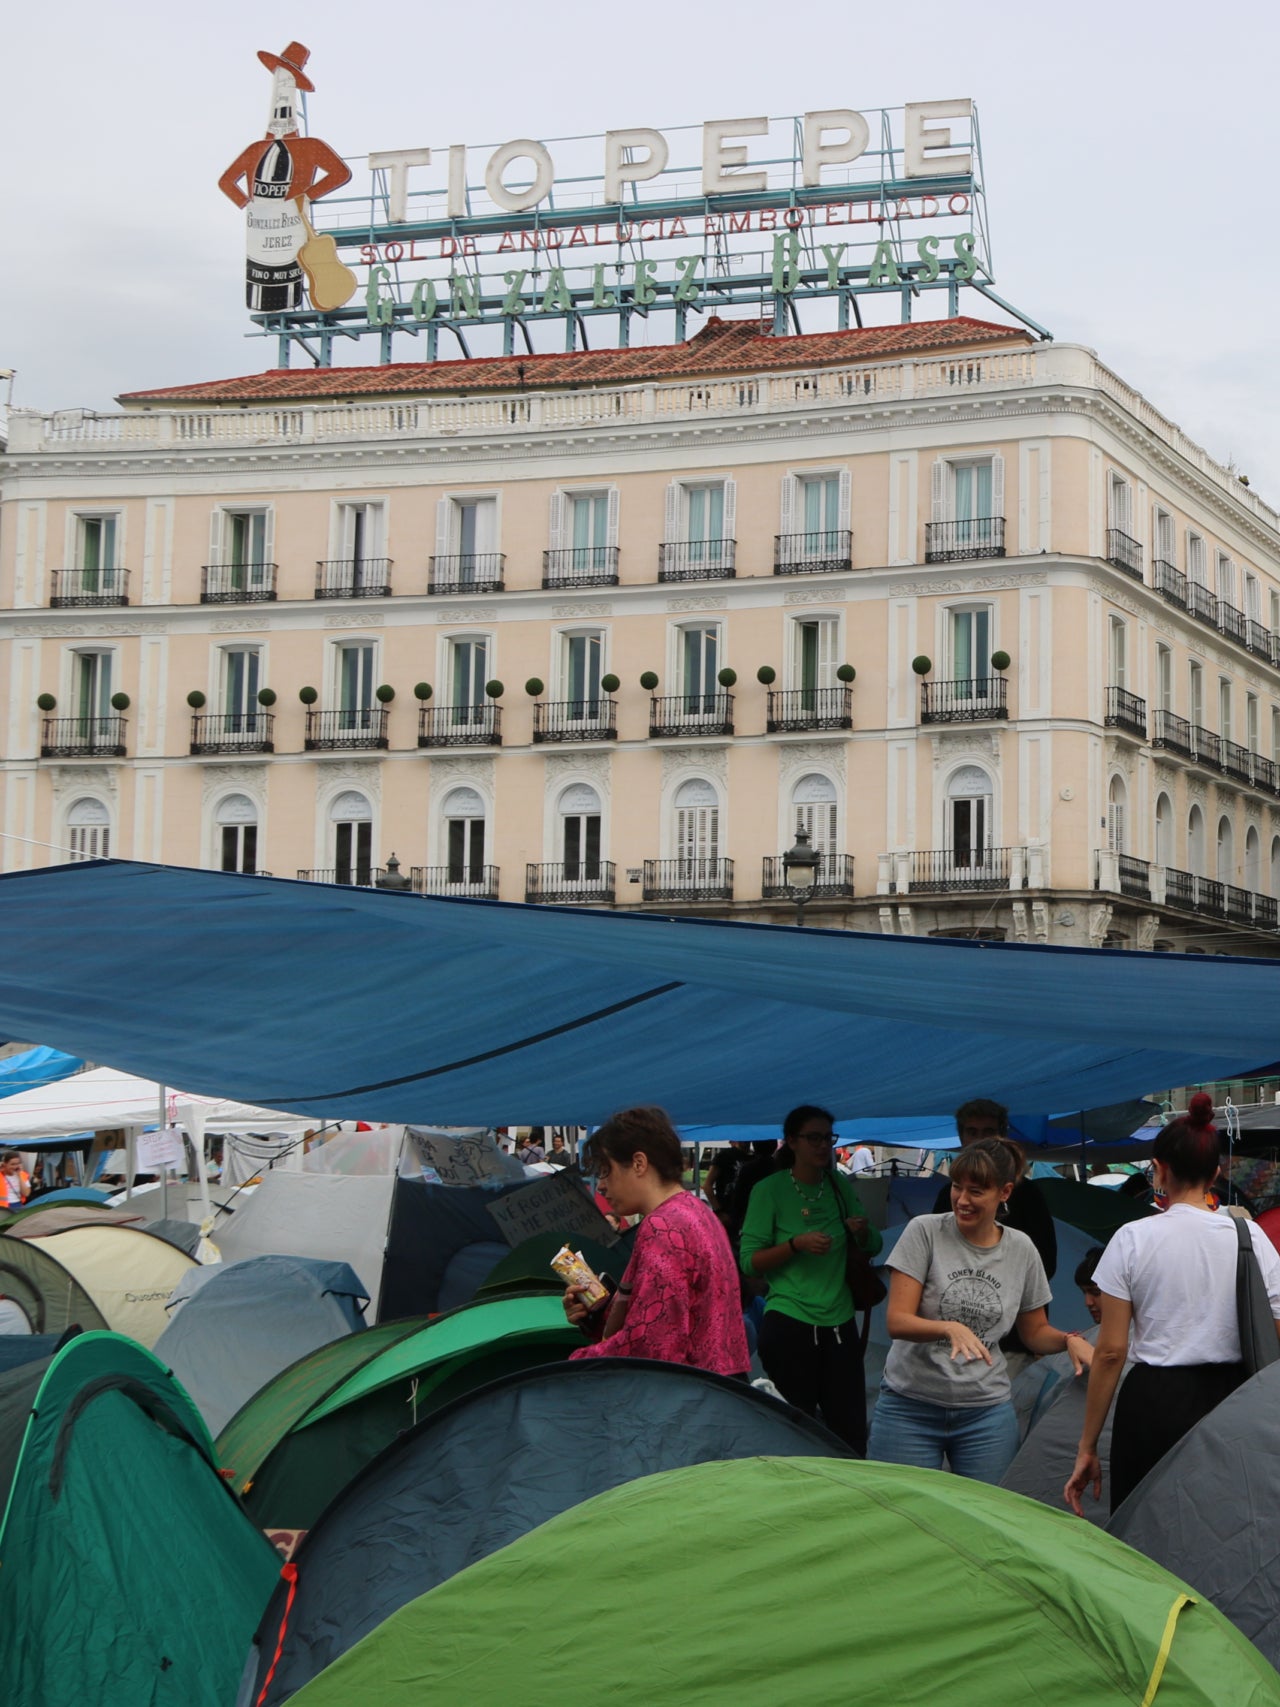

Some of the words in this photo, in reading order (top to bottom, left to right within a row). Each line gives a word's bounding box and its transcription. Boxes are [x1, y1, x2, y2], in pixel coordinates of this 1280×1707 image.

[368, 138, 555, 224] TIO
[603, 97, 972, 205] PEPE
[359, 240, 427, 265] SOL
[440, 235, 482, 259] DE
[497, 215, 688, 254] ANDALUCIA
[704, 192, 970, 236] EMBOTELLADO
[262, 234, 292, 249] JEREZ
[251, 268, 270, 280] FINO
[365, 254, 702, 326] GONZALEZ
[771, 231, 978, 295] BYASS
[947, 1268, 974, 1281] CONEY
[975, 1268, 1002, 1290] ISLAND
[124, 1290, 174, 1303] Quechu
[960, 1299, 986, 1309] WONDER
[960, 1306, 982, 1316] WHEEL
